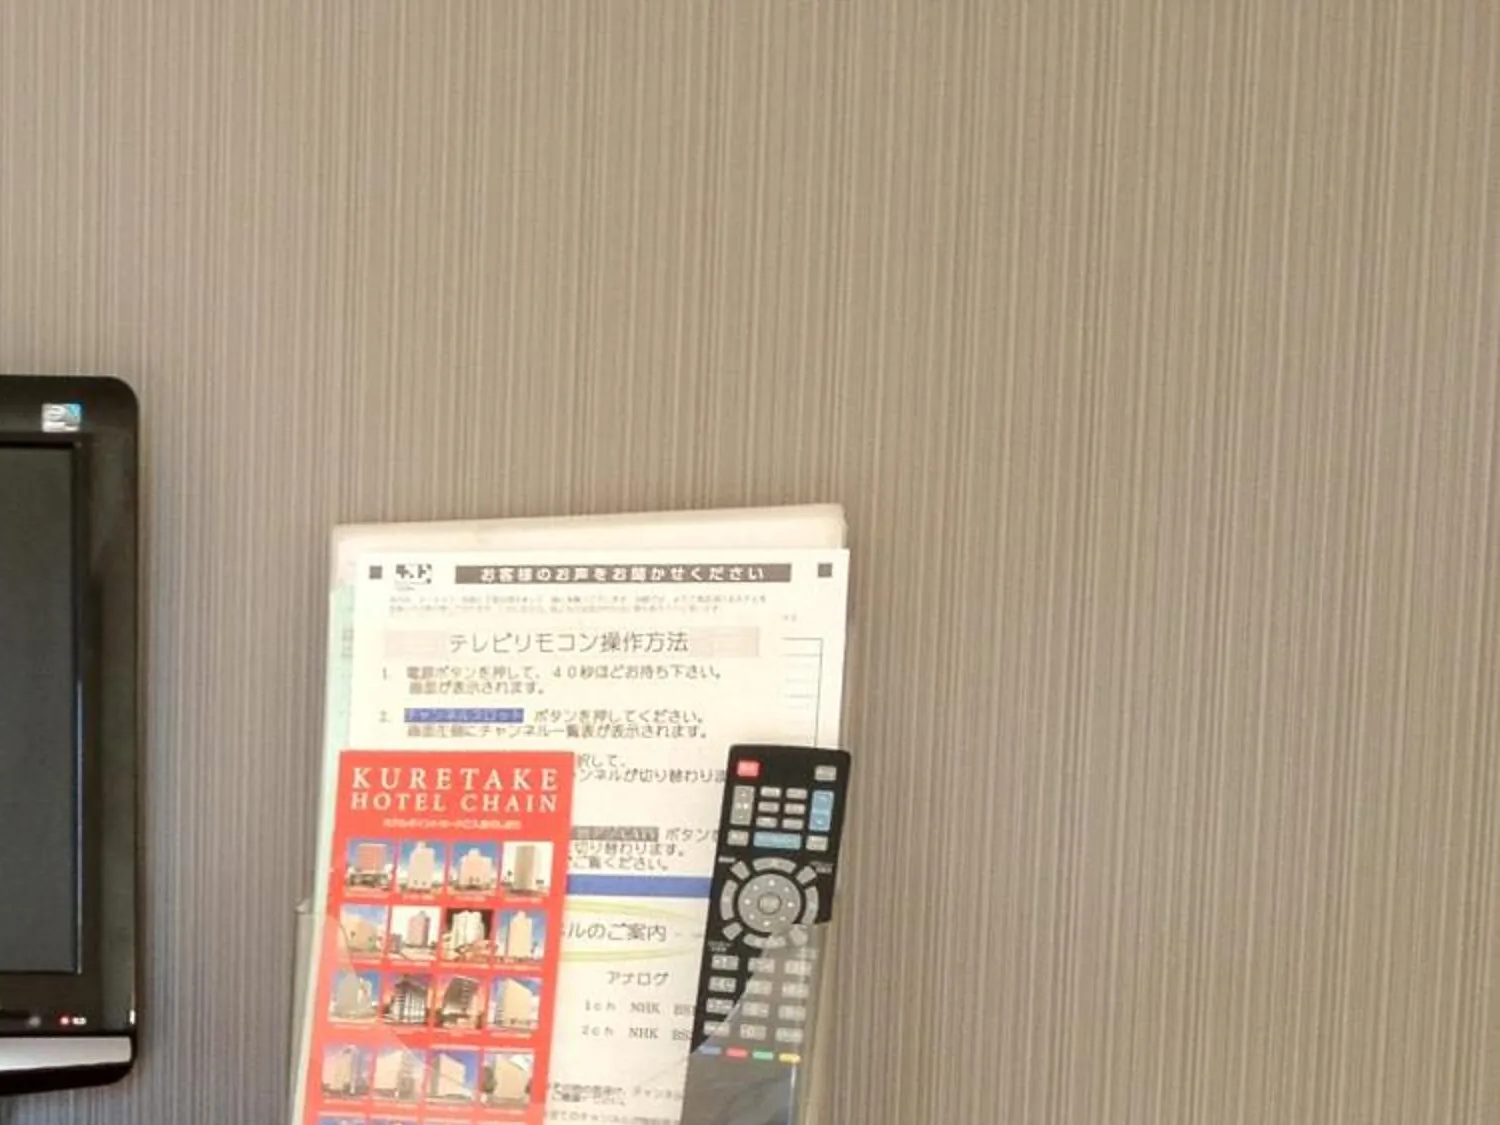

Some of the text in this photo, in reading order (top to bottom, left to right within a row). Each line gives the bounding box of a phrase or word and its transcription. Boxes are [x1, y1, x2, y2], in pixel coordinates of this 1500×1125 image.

[450, 631, 690, 653] テレビリモコン操作方法
[351, 766, 559, 791] KURETAKE
[351, 791, 558, 813] HOTEL CHAIN
[605, 970, 669, 986] アナログ
